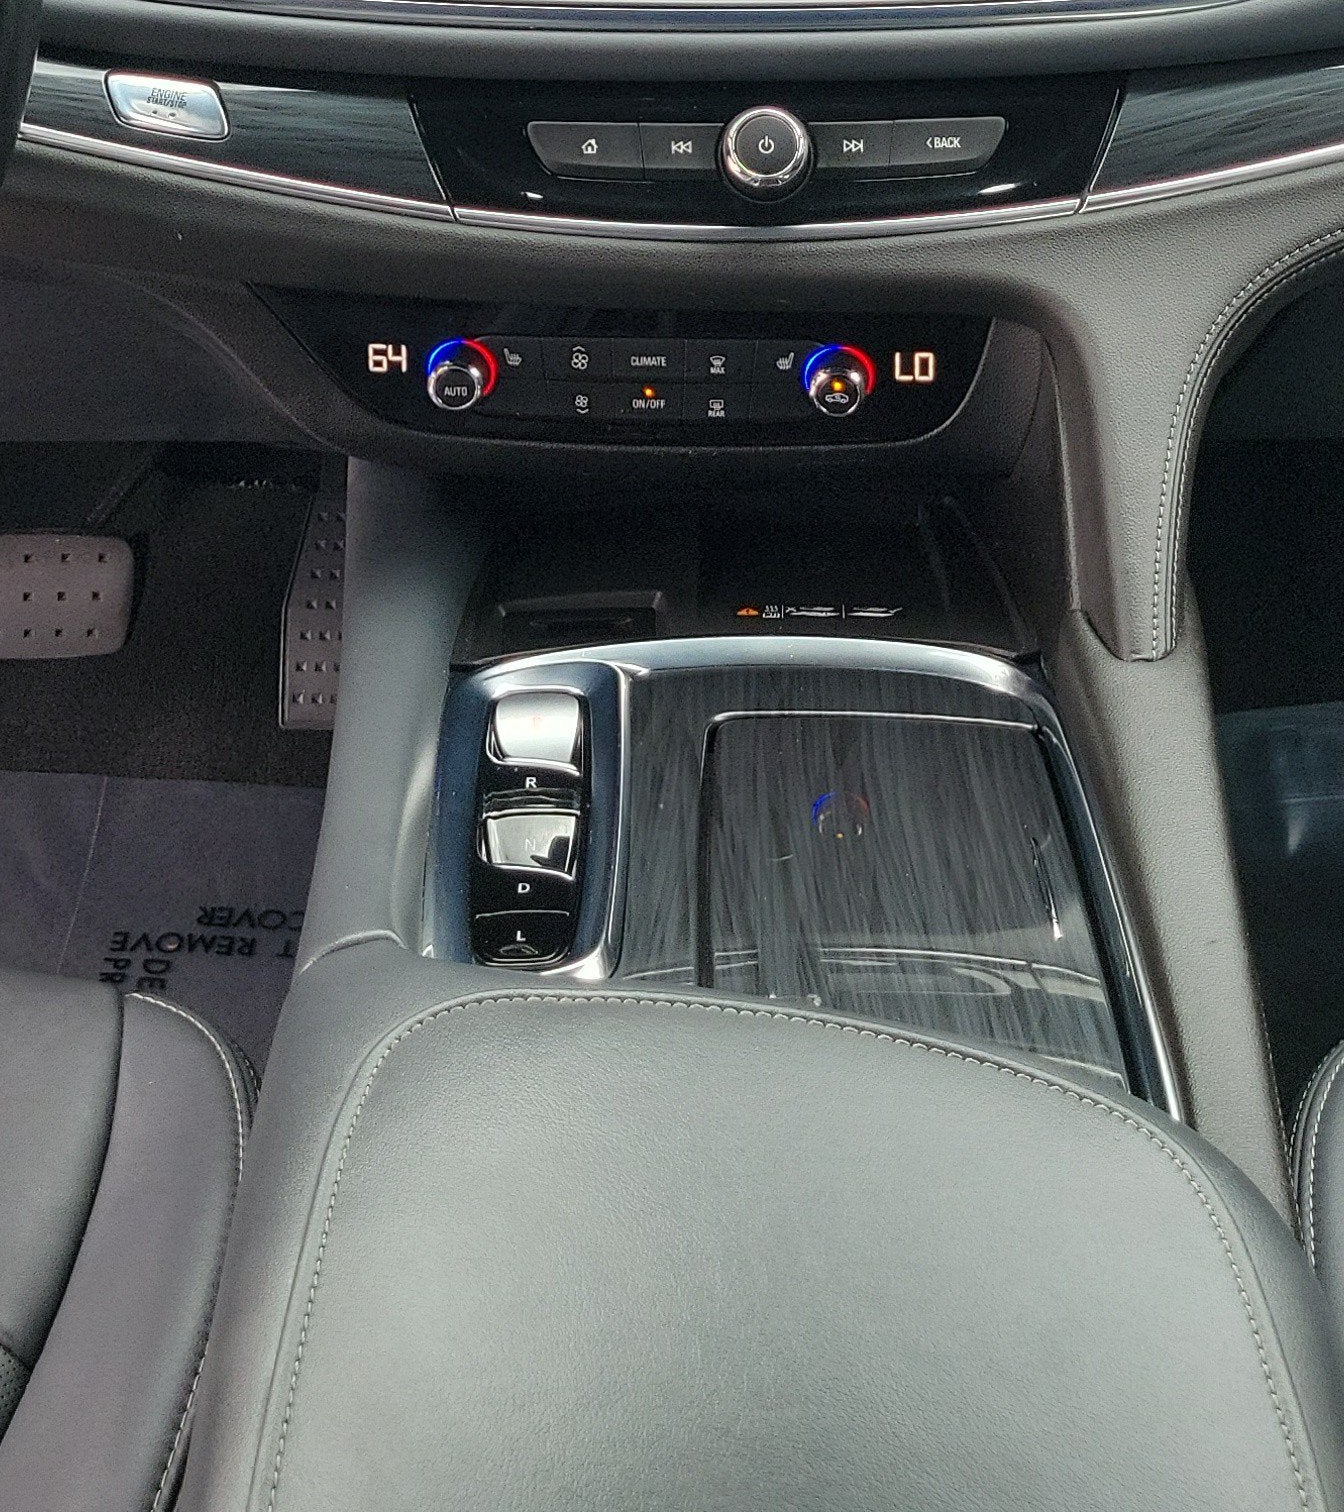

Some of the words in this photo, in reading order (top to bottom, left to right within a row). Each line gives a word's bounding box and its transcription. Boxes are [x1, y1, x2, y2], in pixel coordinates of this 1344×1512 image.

[151, 87, 187, 102] ENGINE
[934, 136, 961, 150] BACK
[367, 343, 407, 373] 64
[630, 356, 667, 367] CLIMATE
[709, 366, 726, 375] MAX
[444, 386, 468, 397] AUTO
[632, 399, 666, 409] ON/OFF
[708, 409, 726, 418] REAR
[525, 776, 538, 788] R
[524, 838, 536, 852] N
[517, 883, 531, 894] D
[196, 906, 304, 932] COVER
[516, 930, 527, 942] L
[109, 931, 257, 957] REMOVE
